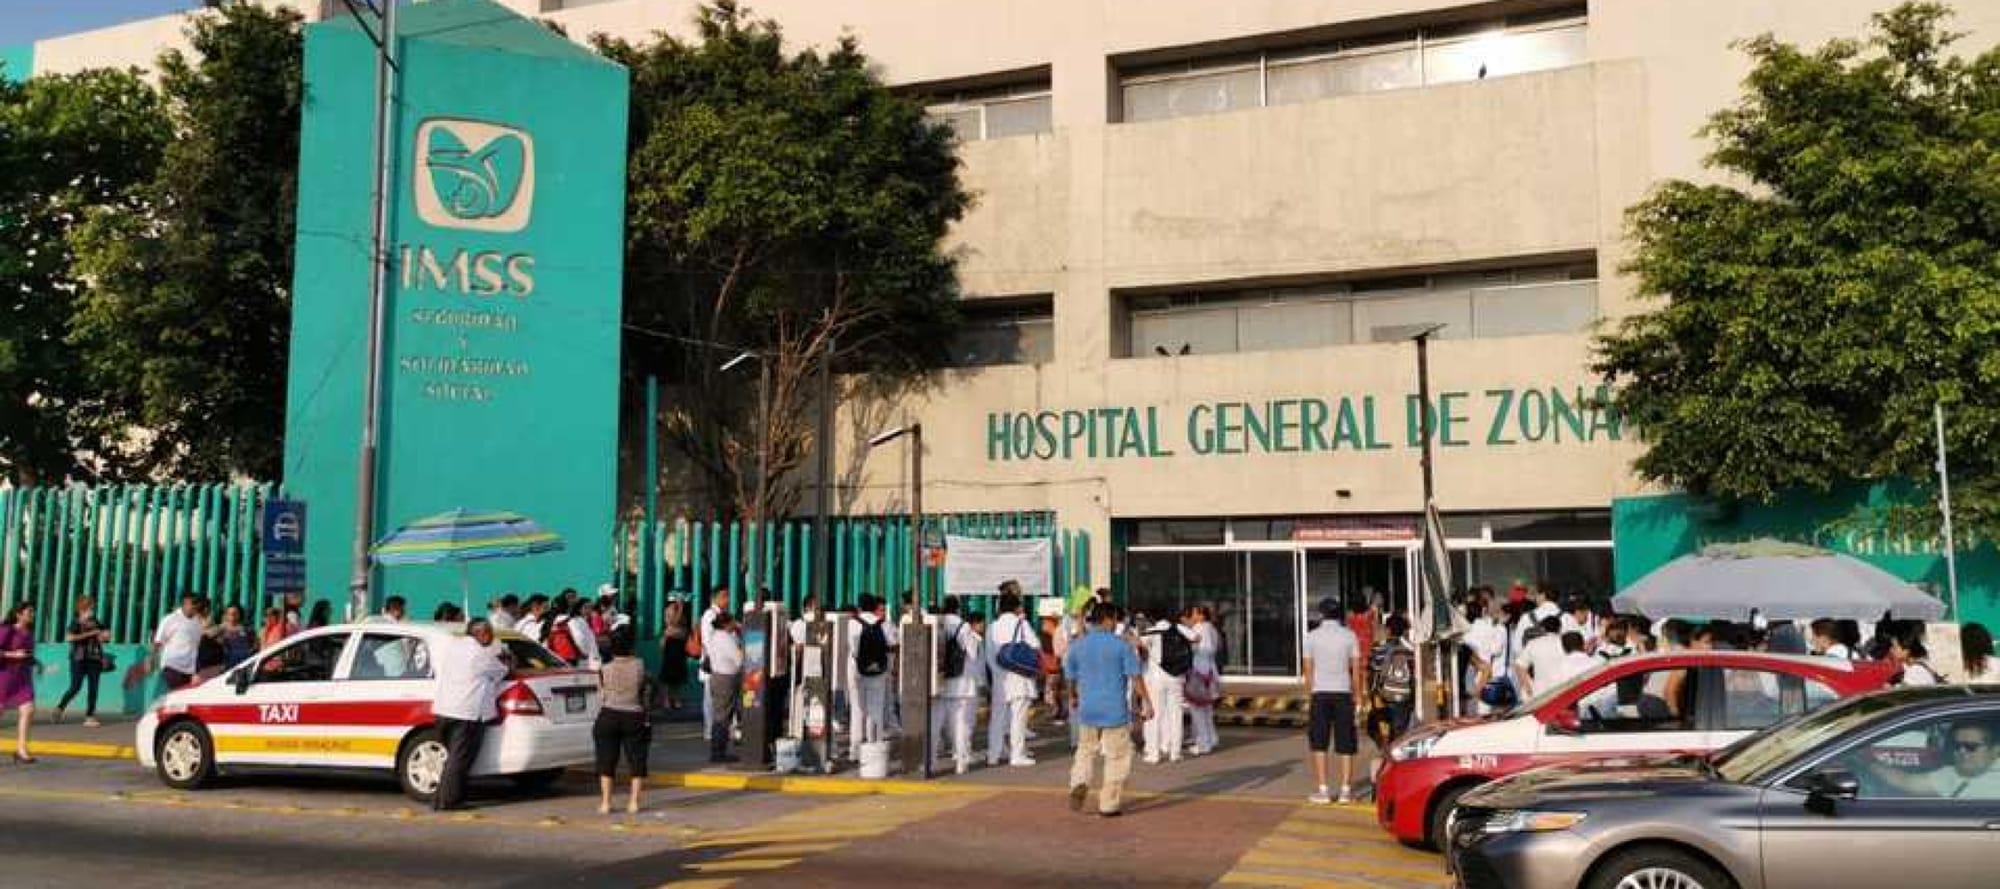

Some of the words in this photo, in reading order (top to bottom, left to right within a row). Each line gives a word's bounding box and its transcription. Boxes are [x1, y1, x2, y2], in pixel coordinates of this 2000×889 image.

[400, 244, 536, 299] IMSS
[987, 406, 1174, 460] HOSPITAL
[1187, 396, 1392, 455] GENERAL
[1406, 391, 1471, 447] DE
[1485, 385, 1625, 446] ZONA
[258, 703, 300, 723] TAXI
